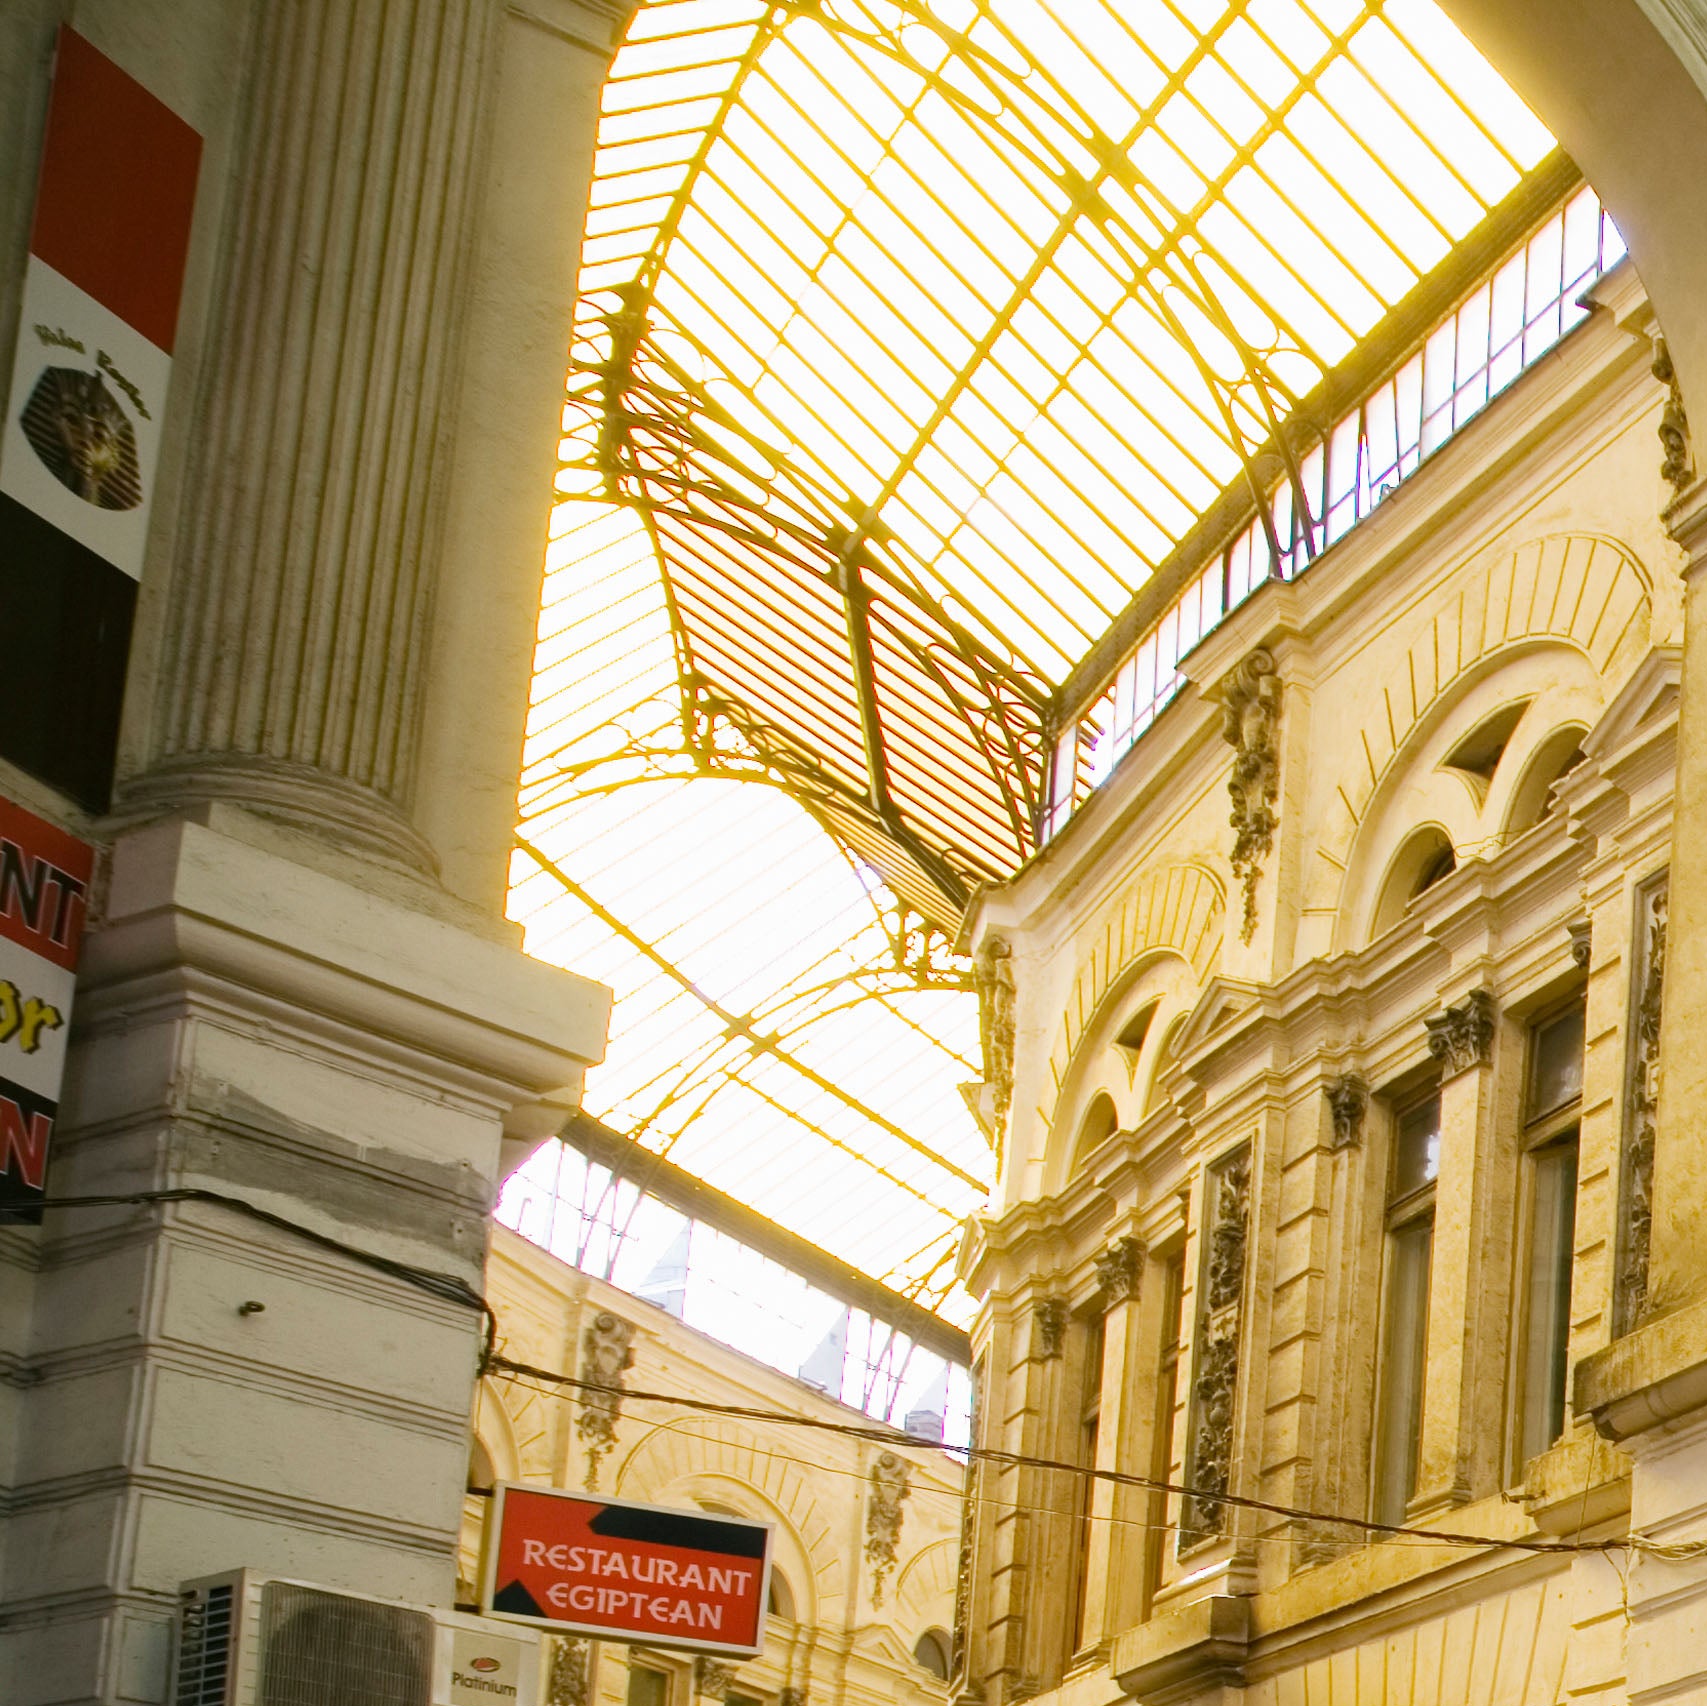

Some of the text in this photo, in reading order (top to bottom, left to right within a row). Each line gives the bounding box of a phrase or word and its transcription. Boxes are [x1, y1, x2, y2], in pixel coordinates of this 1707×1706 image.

[522, 1538, 752, 1597] RESTAURANT
[546, 1582, 723, 1630] EGIPTEAN
[452, 1672, 517, 1698] Platinium
